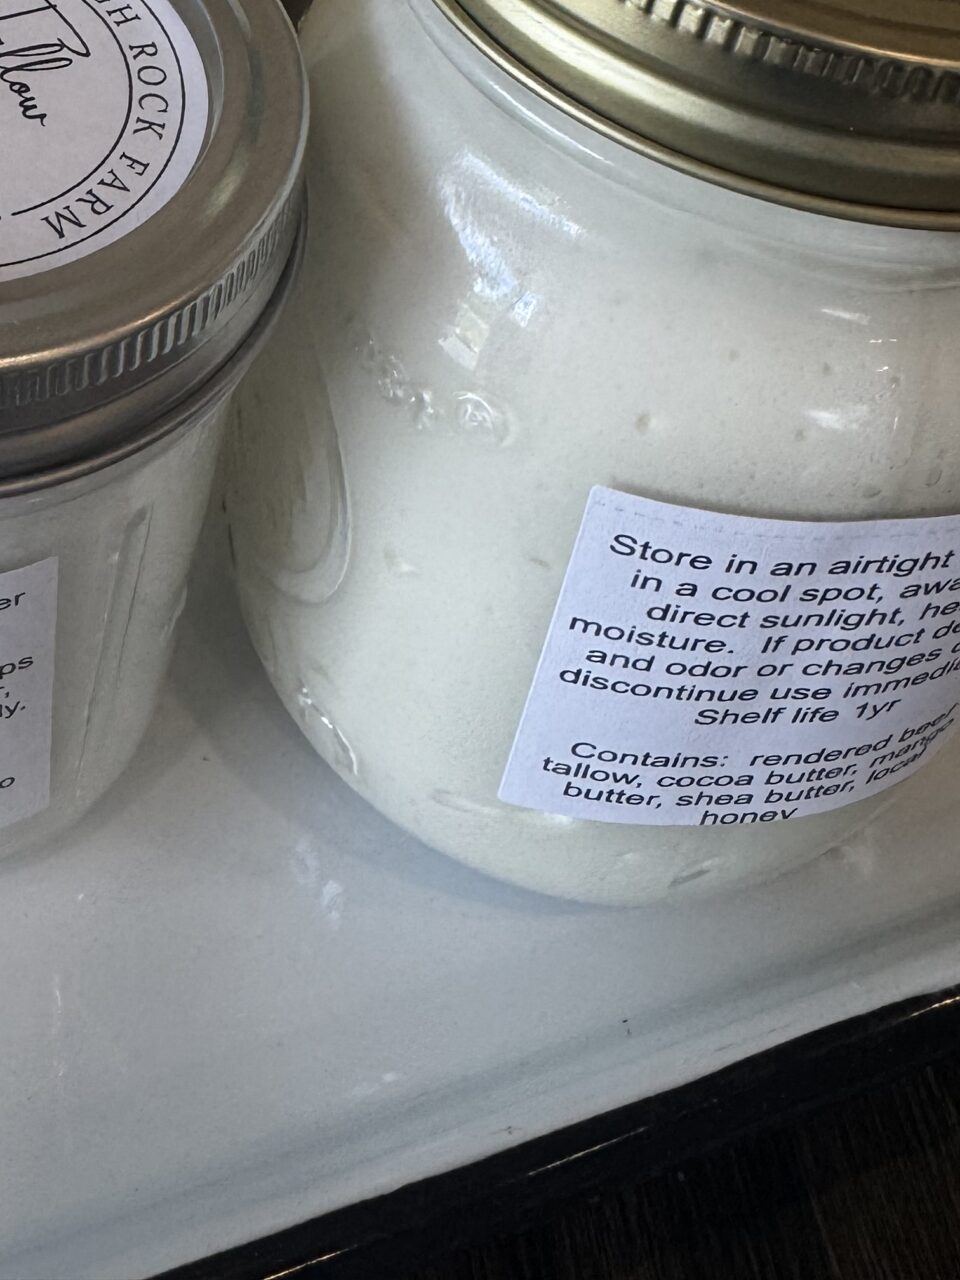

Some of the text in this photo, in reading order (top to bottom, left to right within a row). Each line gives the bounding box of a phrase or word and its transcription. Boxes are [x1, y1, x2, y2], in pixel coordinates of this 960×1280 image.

[128, 42, 169, 140] ROCK
[41, 152, 150, 239] FARM
[609, 534, 956, 578] Store in an airtight
[630, 569, 663, 593] in
[675, 582, 698, 598] a
[711, 584, 792, 603] cool
[799, 583, 884, 606] spot,
[569, 616, 734, 654] moisture.
[761, 635, 789, 654] If
[791, 628, 926, 656] product
[646, 604, 751, 629] direct
[759, 607, 905, 631] sunlight,
[585, 648, 942, 678] and odor or changes
[559, 668, 759, 702] discontinue
[770, 687, 832, 700] use
[694, 699, 902, 726] Shelf life 1yr
[542, 718, 955, 789] tallow, cocoa butter, mango
[571, 742, 729, 769] Contains:
[750, 734, 894, 767] rendered
[563, 744, 928, 809] butter, shea butter, local
